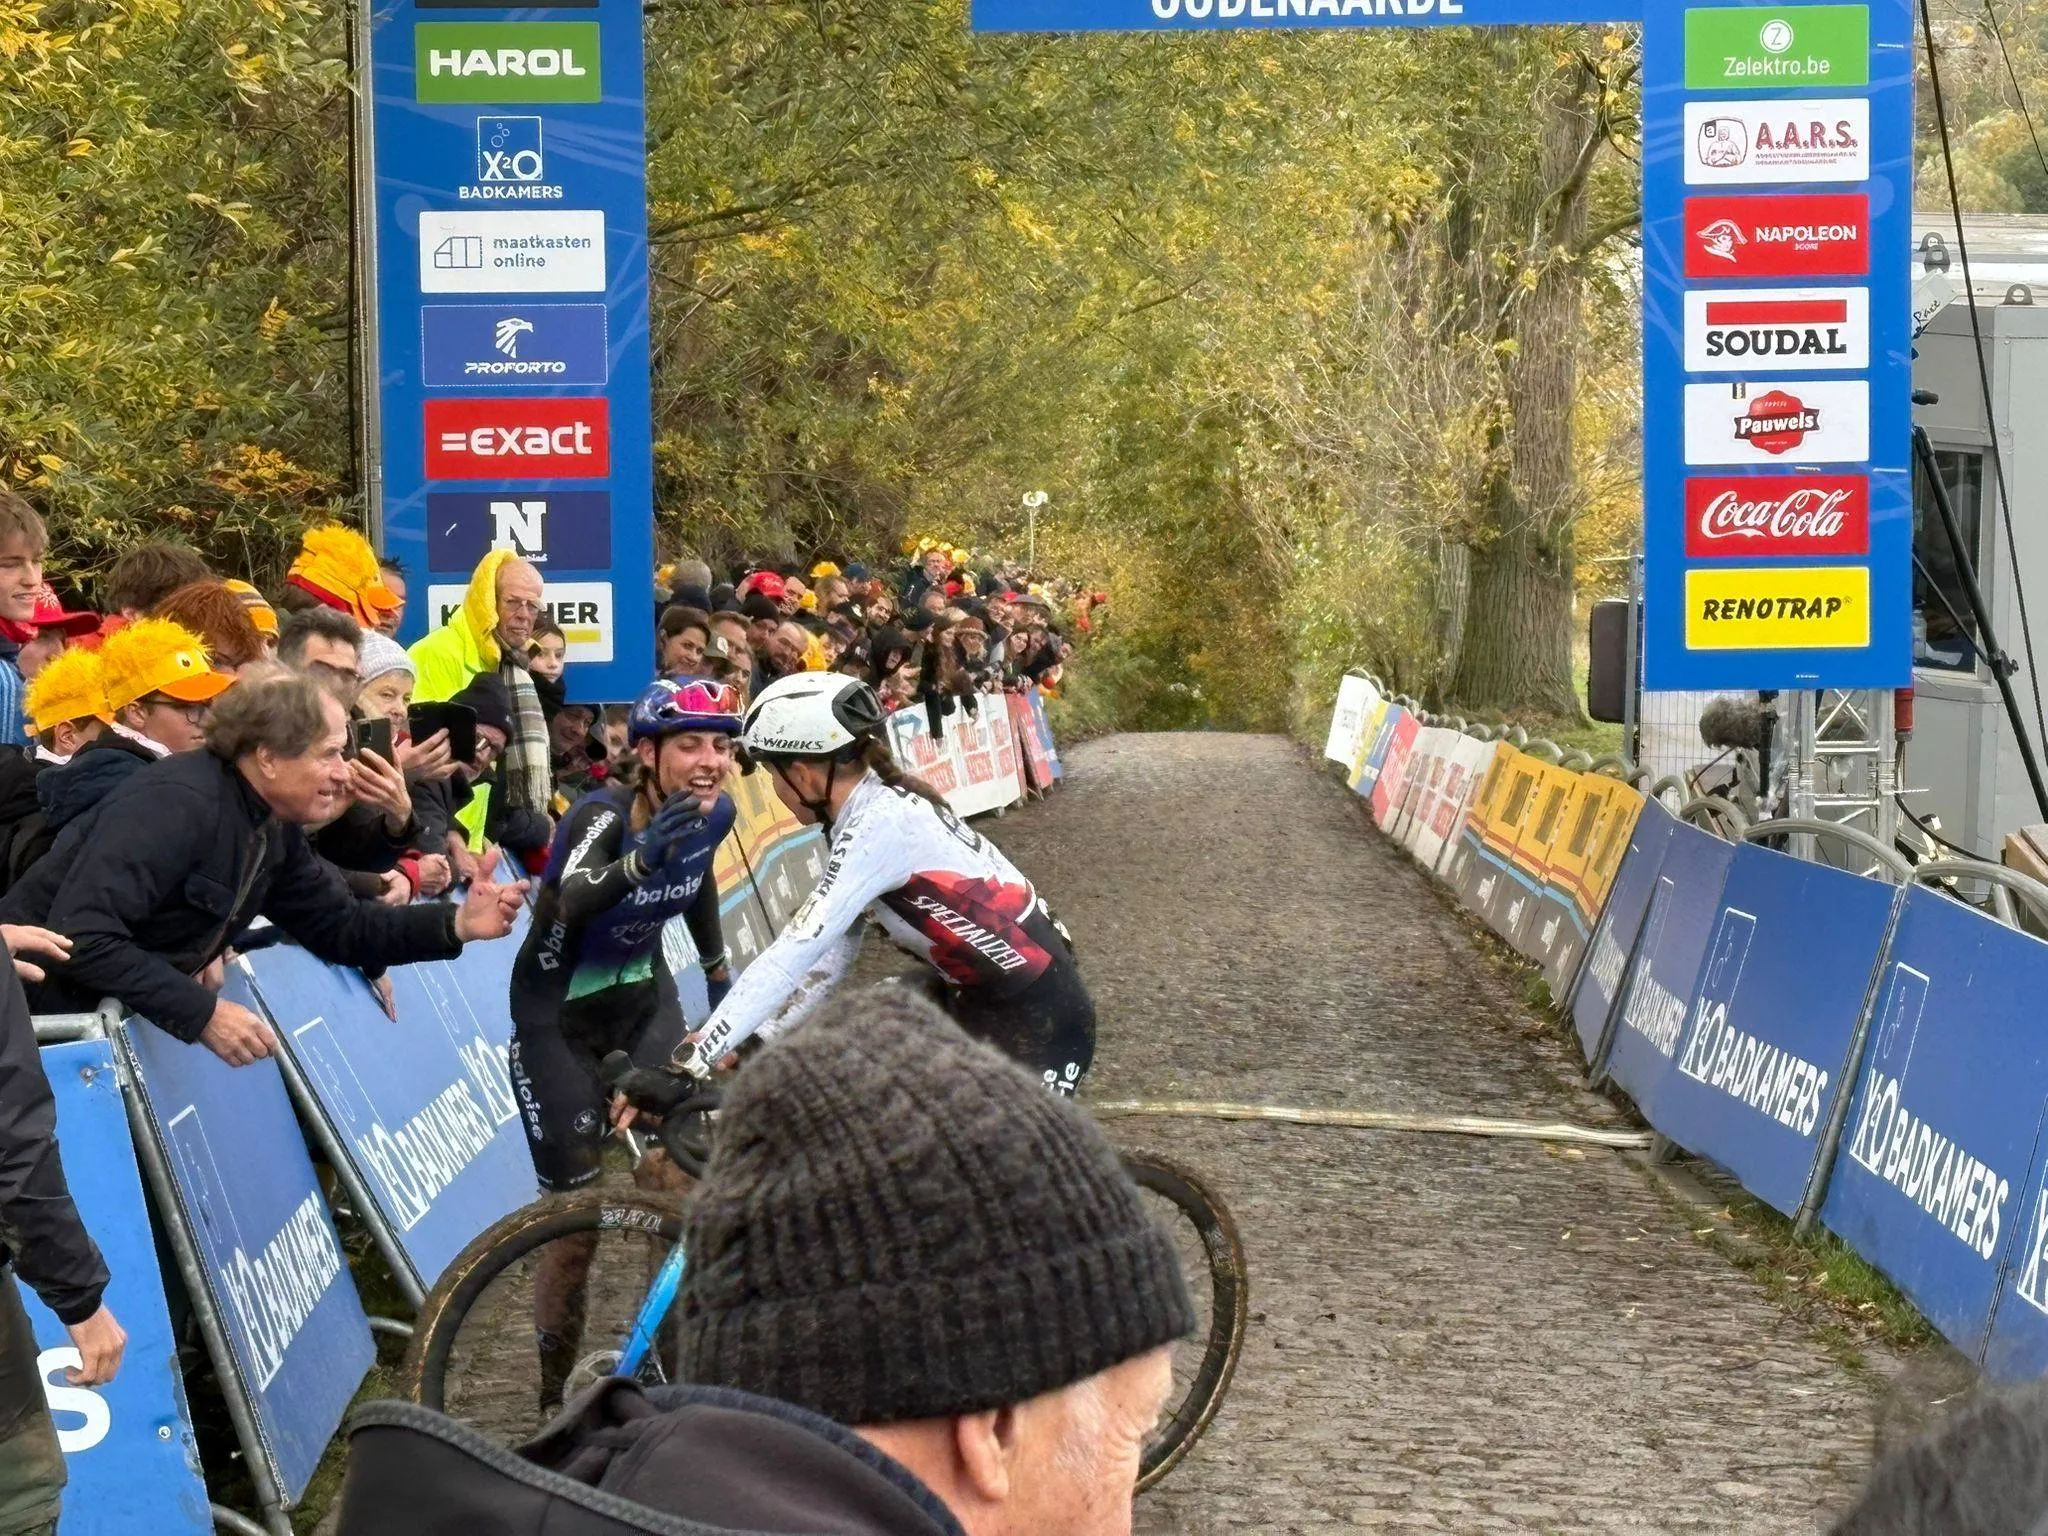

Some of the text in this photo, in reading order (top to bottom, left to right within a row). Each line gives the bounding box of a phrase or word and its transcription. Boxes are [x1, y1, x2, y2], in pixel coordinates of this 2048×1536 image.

[430, 48, 586, 77] HAROL
[1723, 56, 1830, 76] Zelektro.be
[1756, 120, 1858, 149] A.A.R.S.
[459, 185, 563, 199] BADKAMERS
[493, 234, 591, 249] maatkasten
[1756, 225, 1857, 243] NAPOLEON
[493, 253, 546, 268] online
[1706, 328, 1847, 357] SOUDAL
[464, 361, 567, 375] PROFORTO
[1740, 411, 1815, 435] Pauwels
[1701, 489, 1853, 538] Coca-Cola
[907, 895, 1028, 970] SPECIALIZED
[1711, 1025, 1829, 1136] BADKAMERS
[395, 1078, 495, 1200] BADKAMERS
[1882, 1107, 2009, 1260] BADKAMERS
[254, 1190, 341, 1350] BADKAMERS
